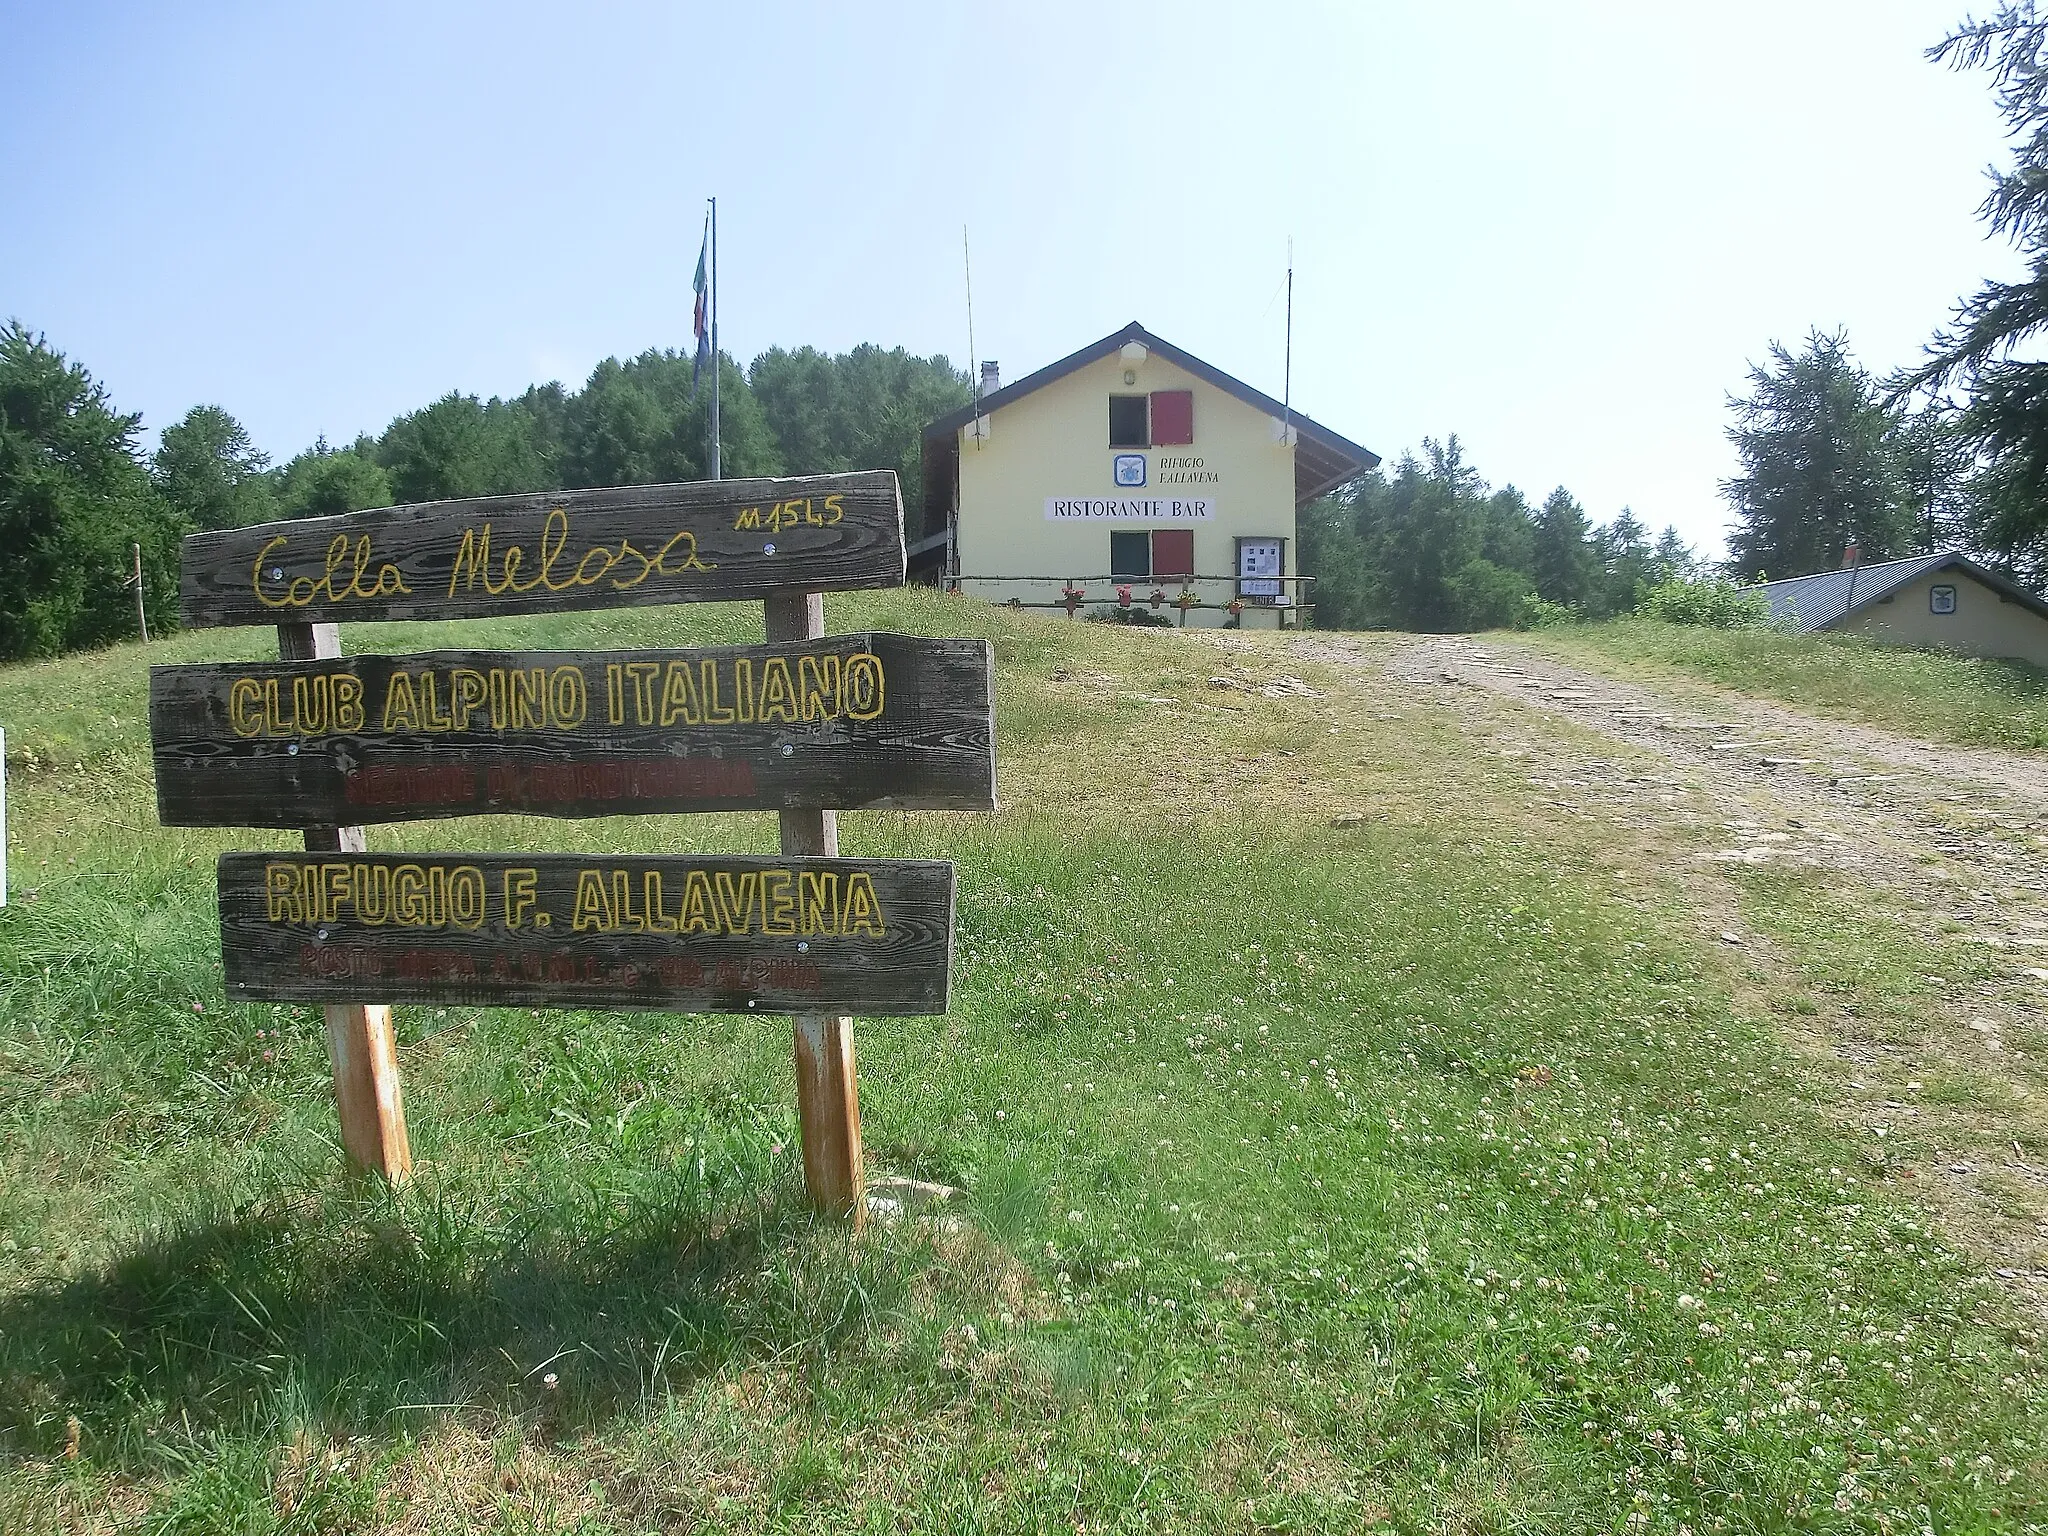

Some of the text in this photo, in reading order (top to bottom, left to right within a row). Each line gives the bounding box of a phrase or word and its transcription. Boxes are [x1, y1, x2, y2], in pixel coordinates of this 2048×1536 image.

[1160, 457, 1204, 469] RIFUGIO
[1054, 501, 1206, 517] RISTORANTE BAR
[252, 508, 718, 607] Colla Melosa
[229, 653, 886, 737] CLUB ALPINO ITALIANO
[265, 862, 887, 938] RIFUGIO F. ALLAVENA
[299, 944, 382, 979] POSTO
